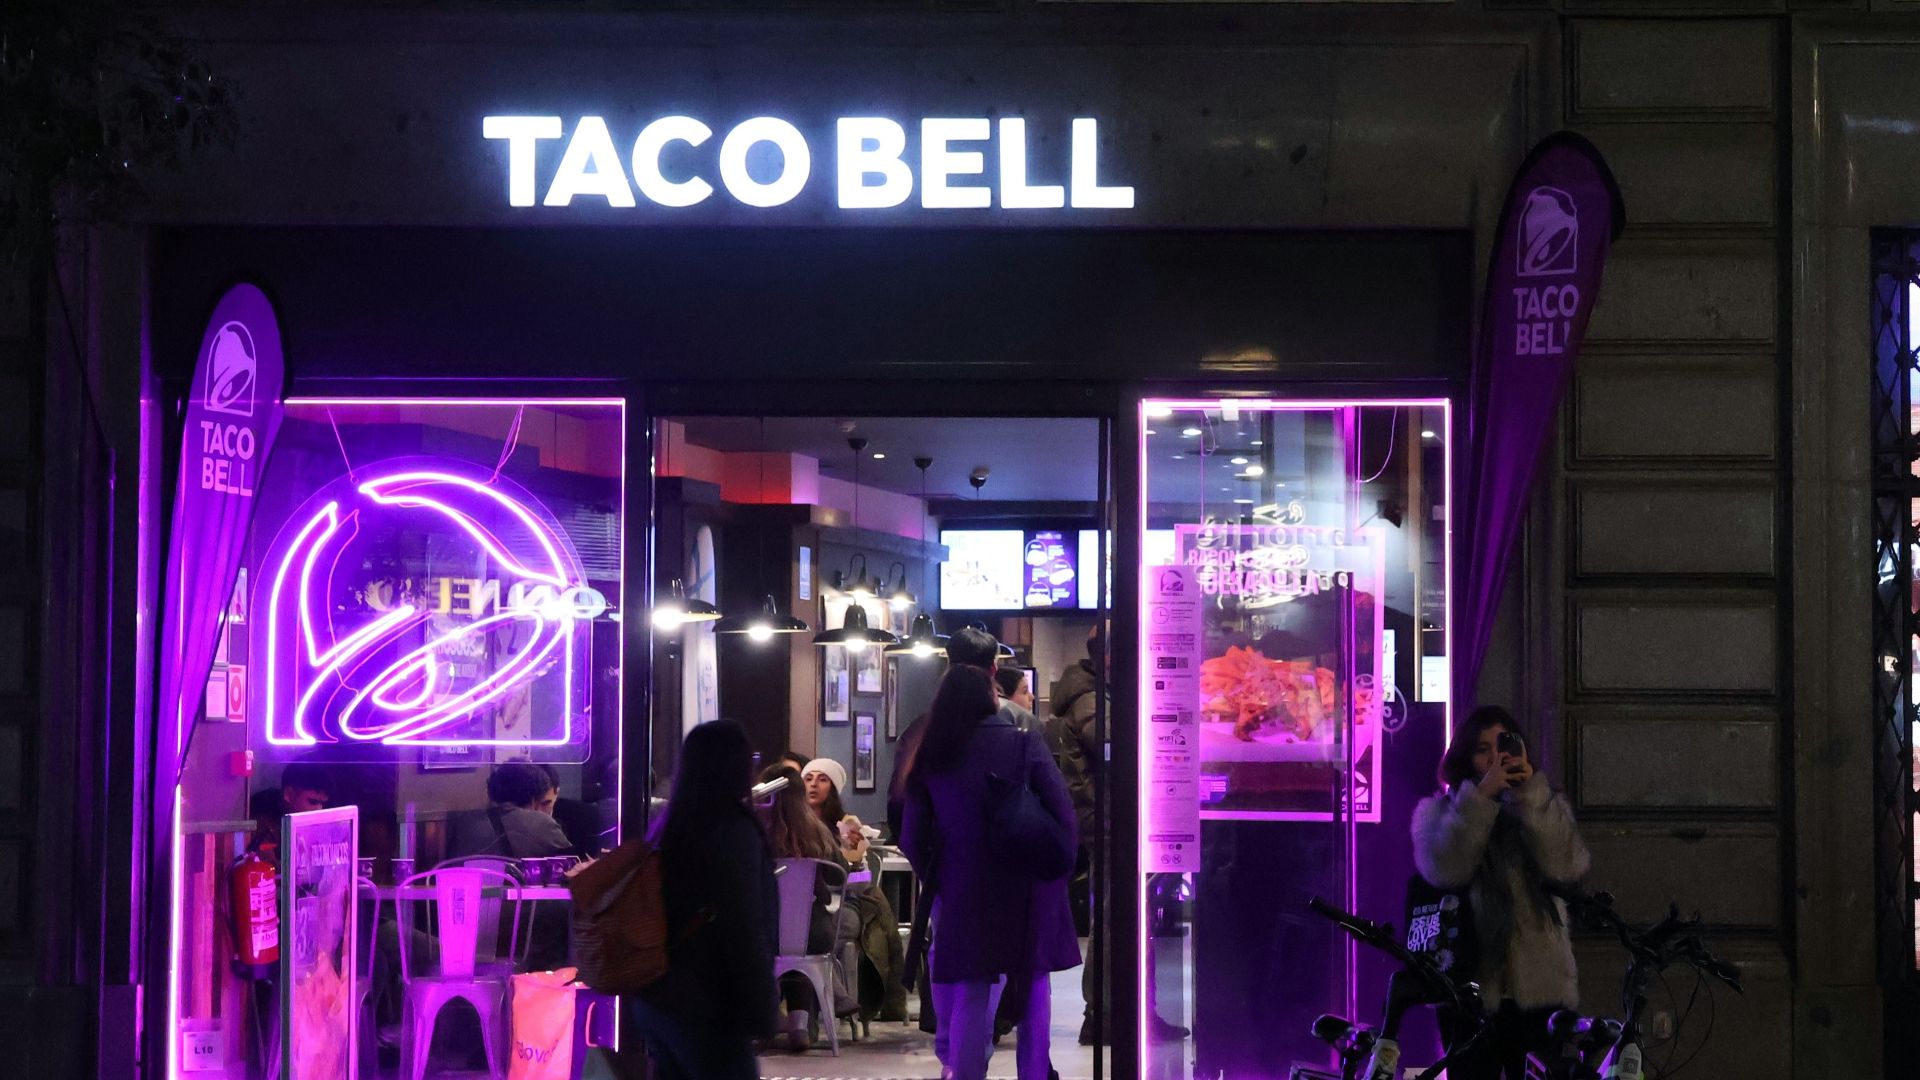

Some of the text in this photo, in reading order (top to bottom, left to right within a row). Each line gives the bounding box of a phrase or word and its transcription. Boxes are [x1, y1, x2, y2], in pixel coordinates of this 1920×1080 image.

[482, 115, 1135, 210] TACO BELL
[1513, 284, 1580, 319] TACO
[201, 420, 255, 460] TACO
[201, 456, 252, 497] BELL
[194, 1046, 214, 1055] L10
